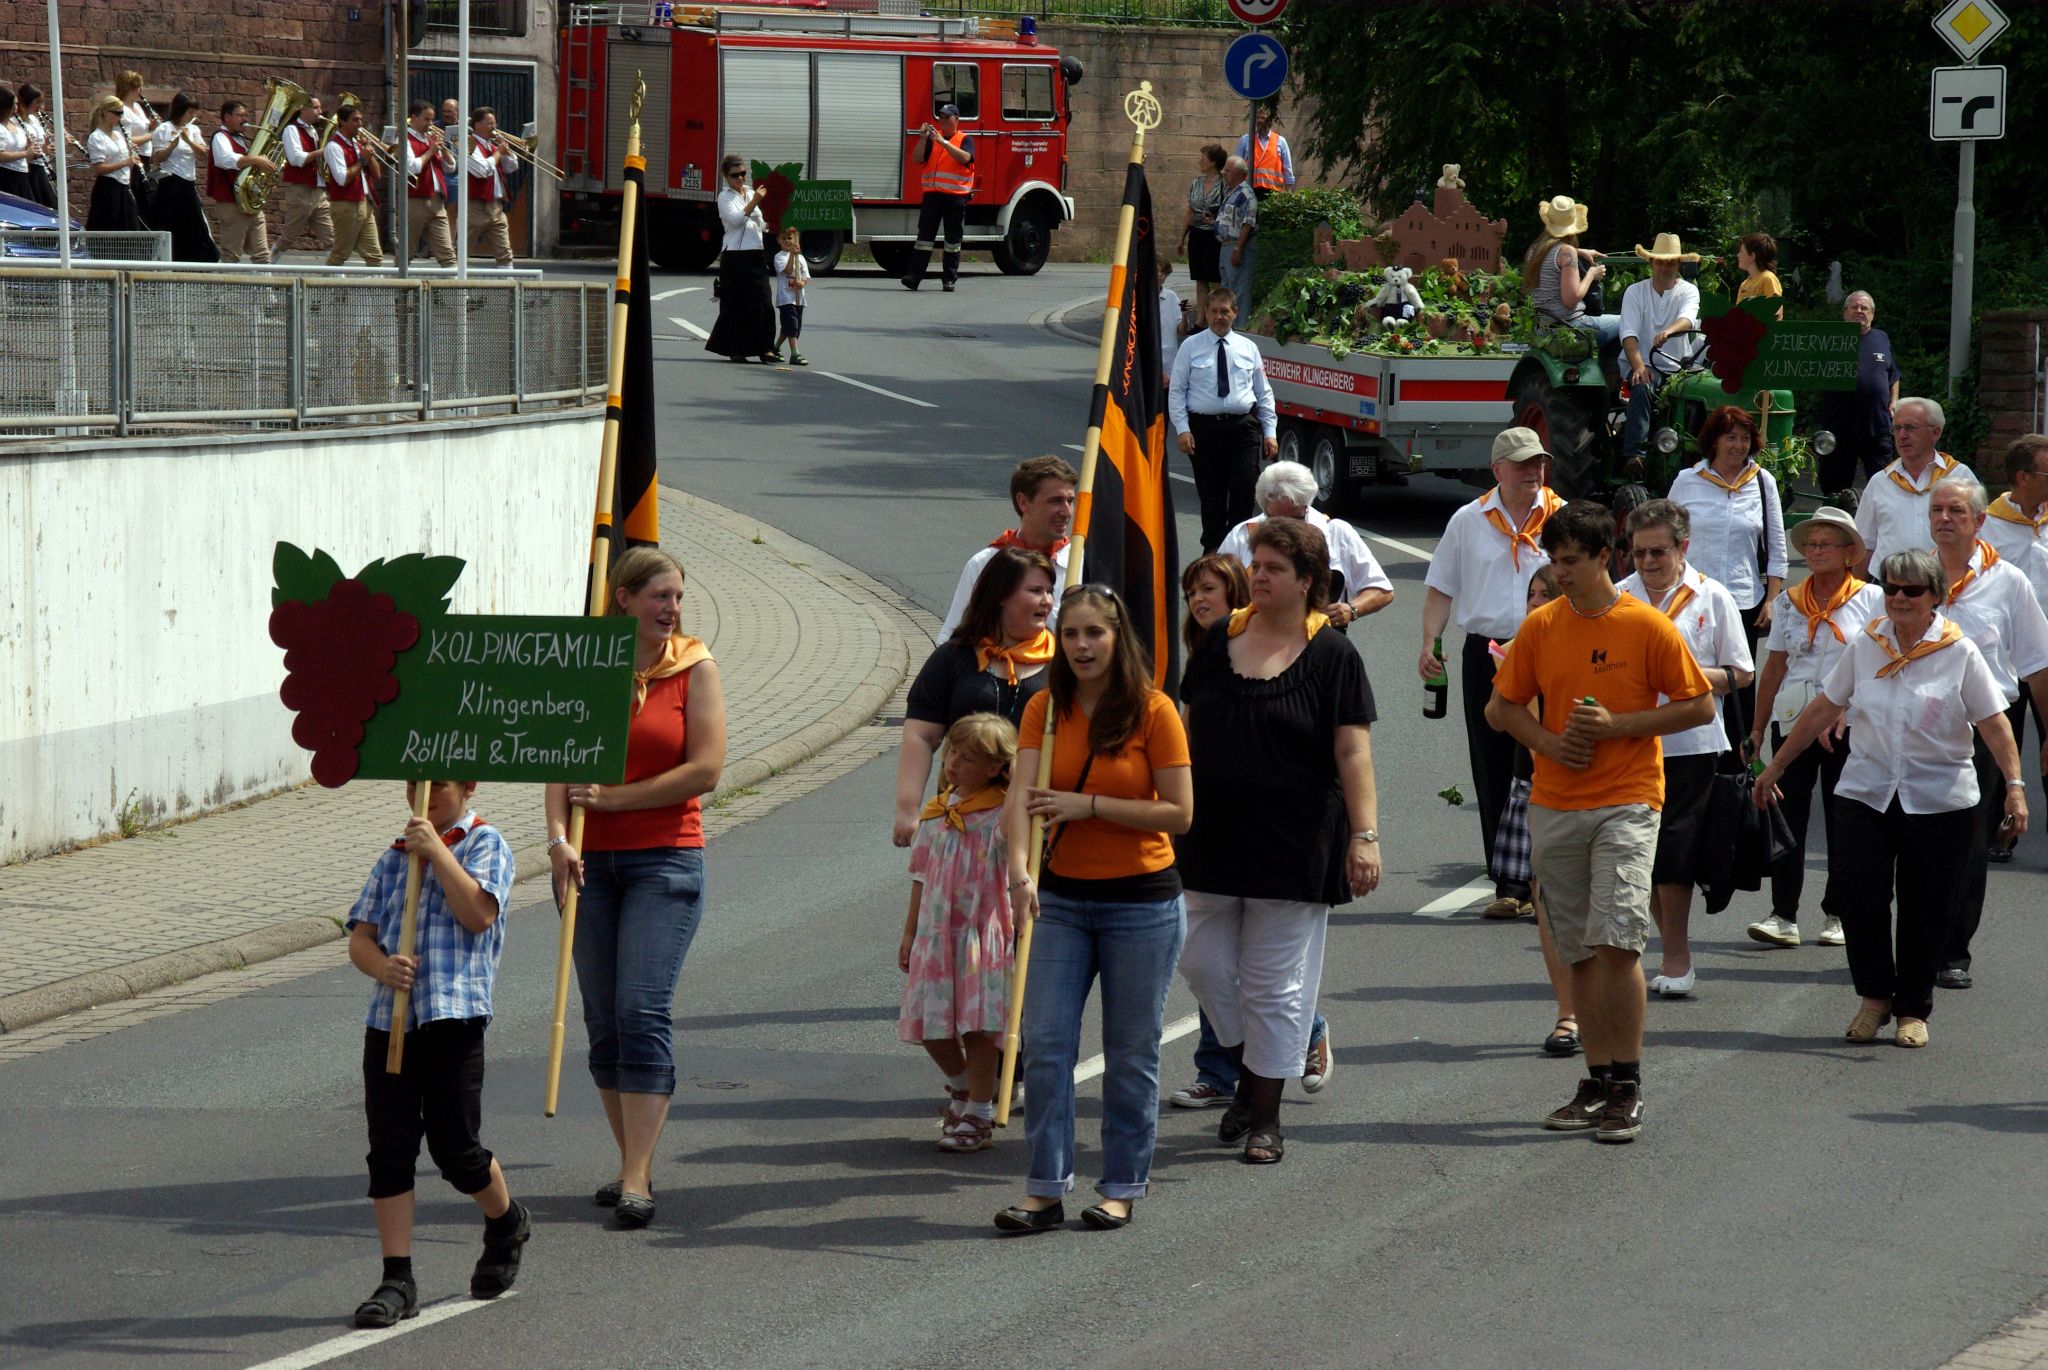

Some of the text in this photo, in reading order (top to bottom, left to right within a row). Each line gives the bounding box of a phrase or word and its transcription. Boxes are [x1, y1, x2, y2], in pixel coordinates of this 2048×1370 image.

[793, 189, 850, 202] MUSIKVEREIN
[1772, 334, 1859, 351] FEUERWEHR
[1263, 359, 1355, 392] EUERWEHR KLINGENBERG
[1763, 360, 1858, 378] KLINGENBERG
[427, 629, 632, 669] KOLPINGFAMILIE
[457, 680, 590, 724] Klingenberg,
[401, 730, 478, 768] Röllfeld
